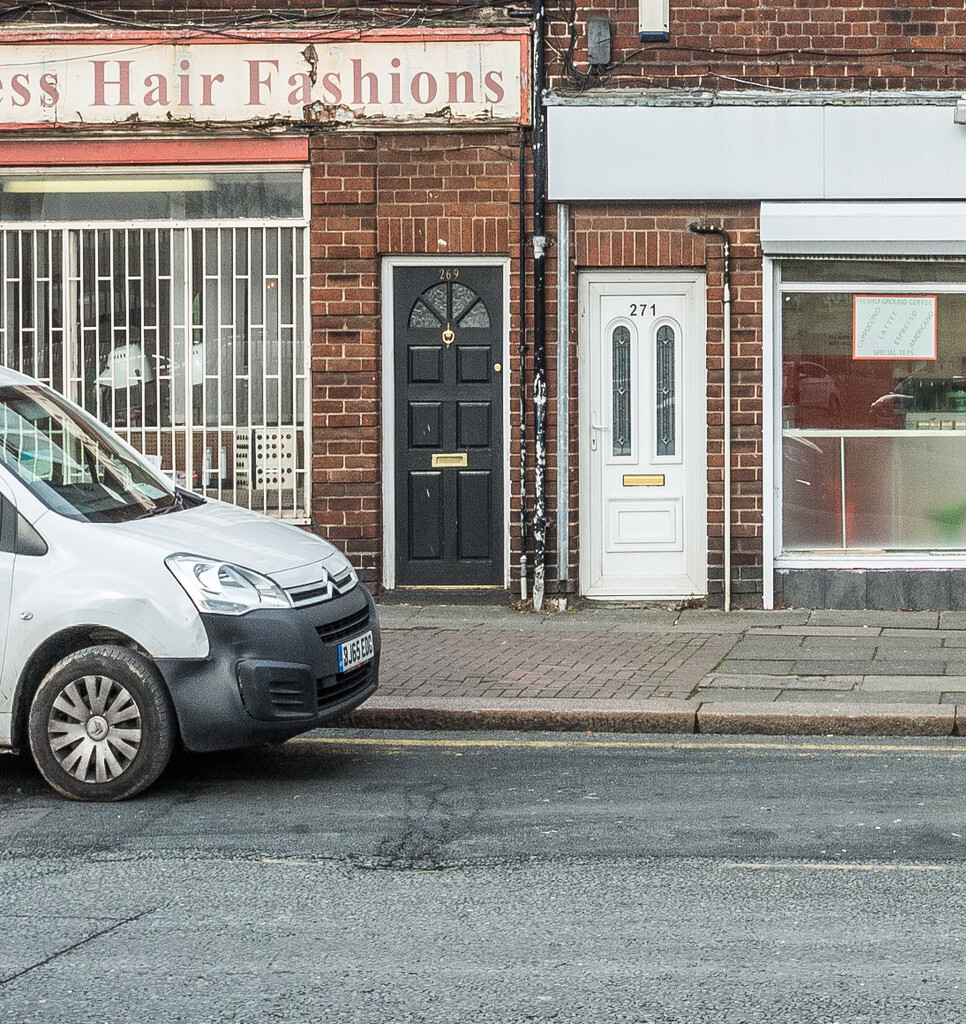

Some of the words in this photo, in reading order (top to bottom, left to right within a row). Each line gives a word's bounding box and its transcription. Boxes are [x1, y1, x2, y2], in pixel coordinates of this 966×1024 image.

[0, 73, 59, 107] ess
[88, 58, 224, 107] Hair
[244, 57, 505, 106] Fashions
[439, 268, 459, 280] 269
[630, 303, 656, 316] 271
[893, 310, 918, 346] ESPRESSO
[909, 311, 934, 349] AMERICANO
